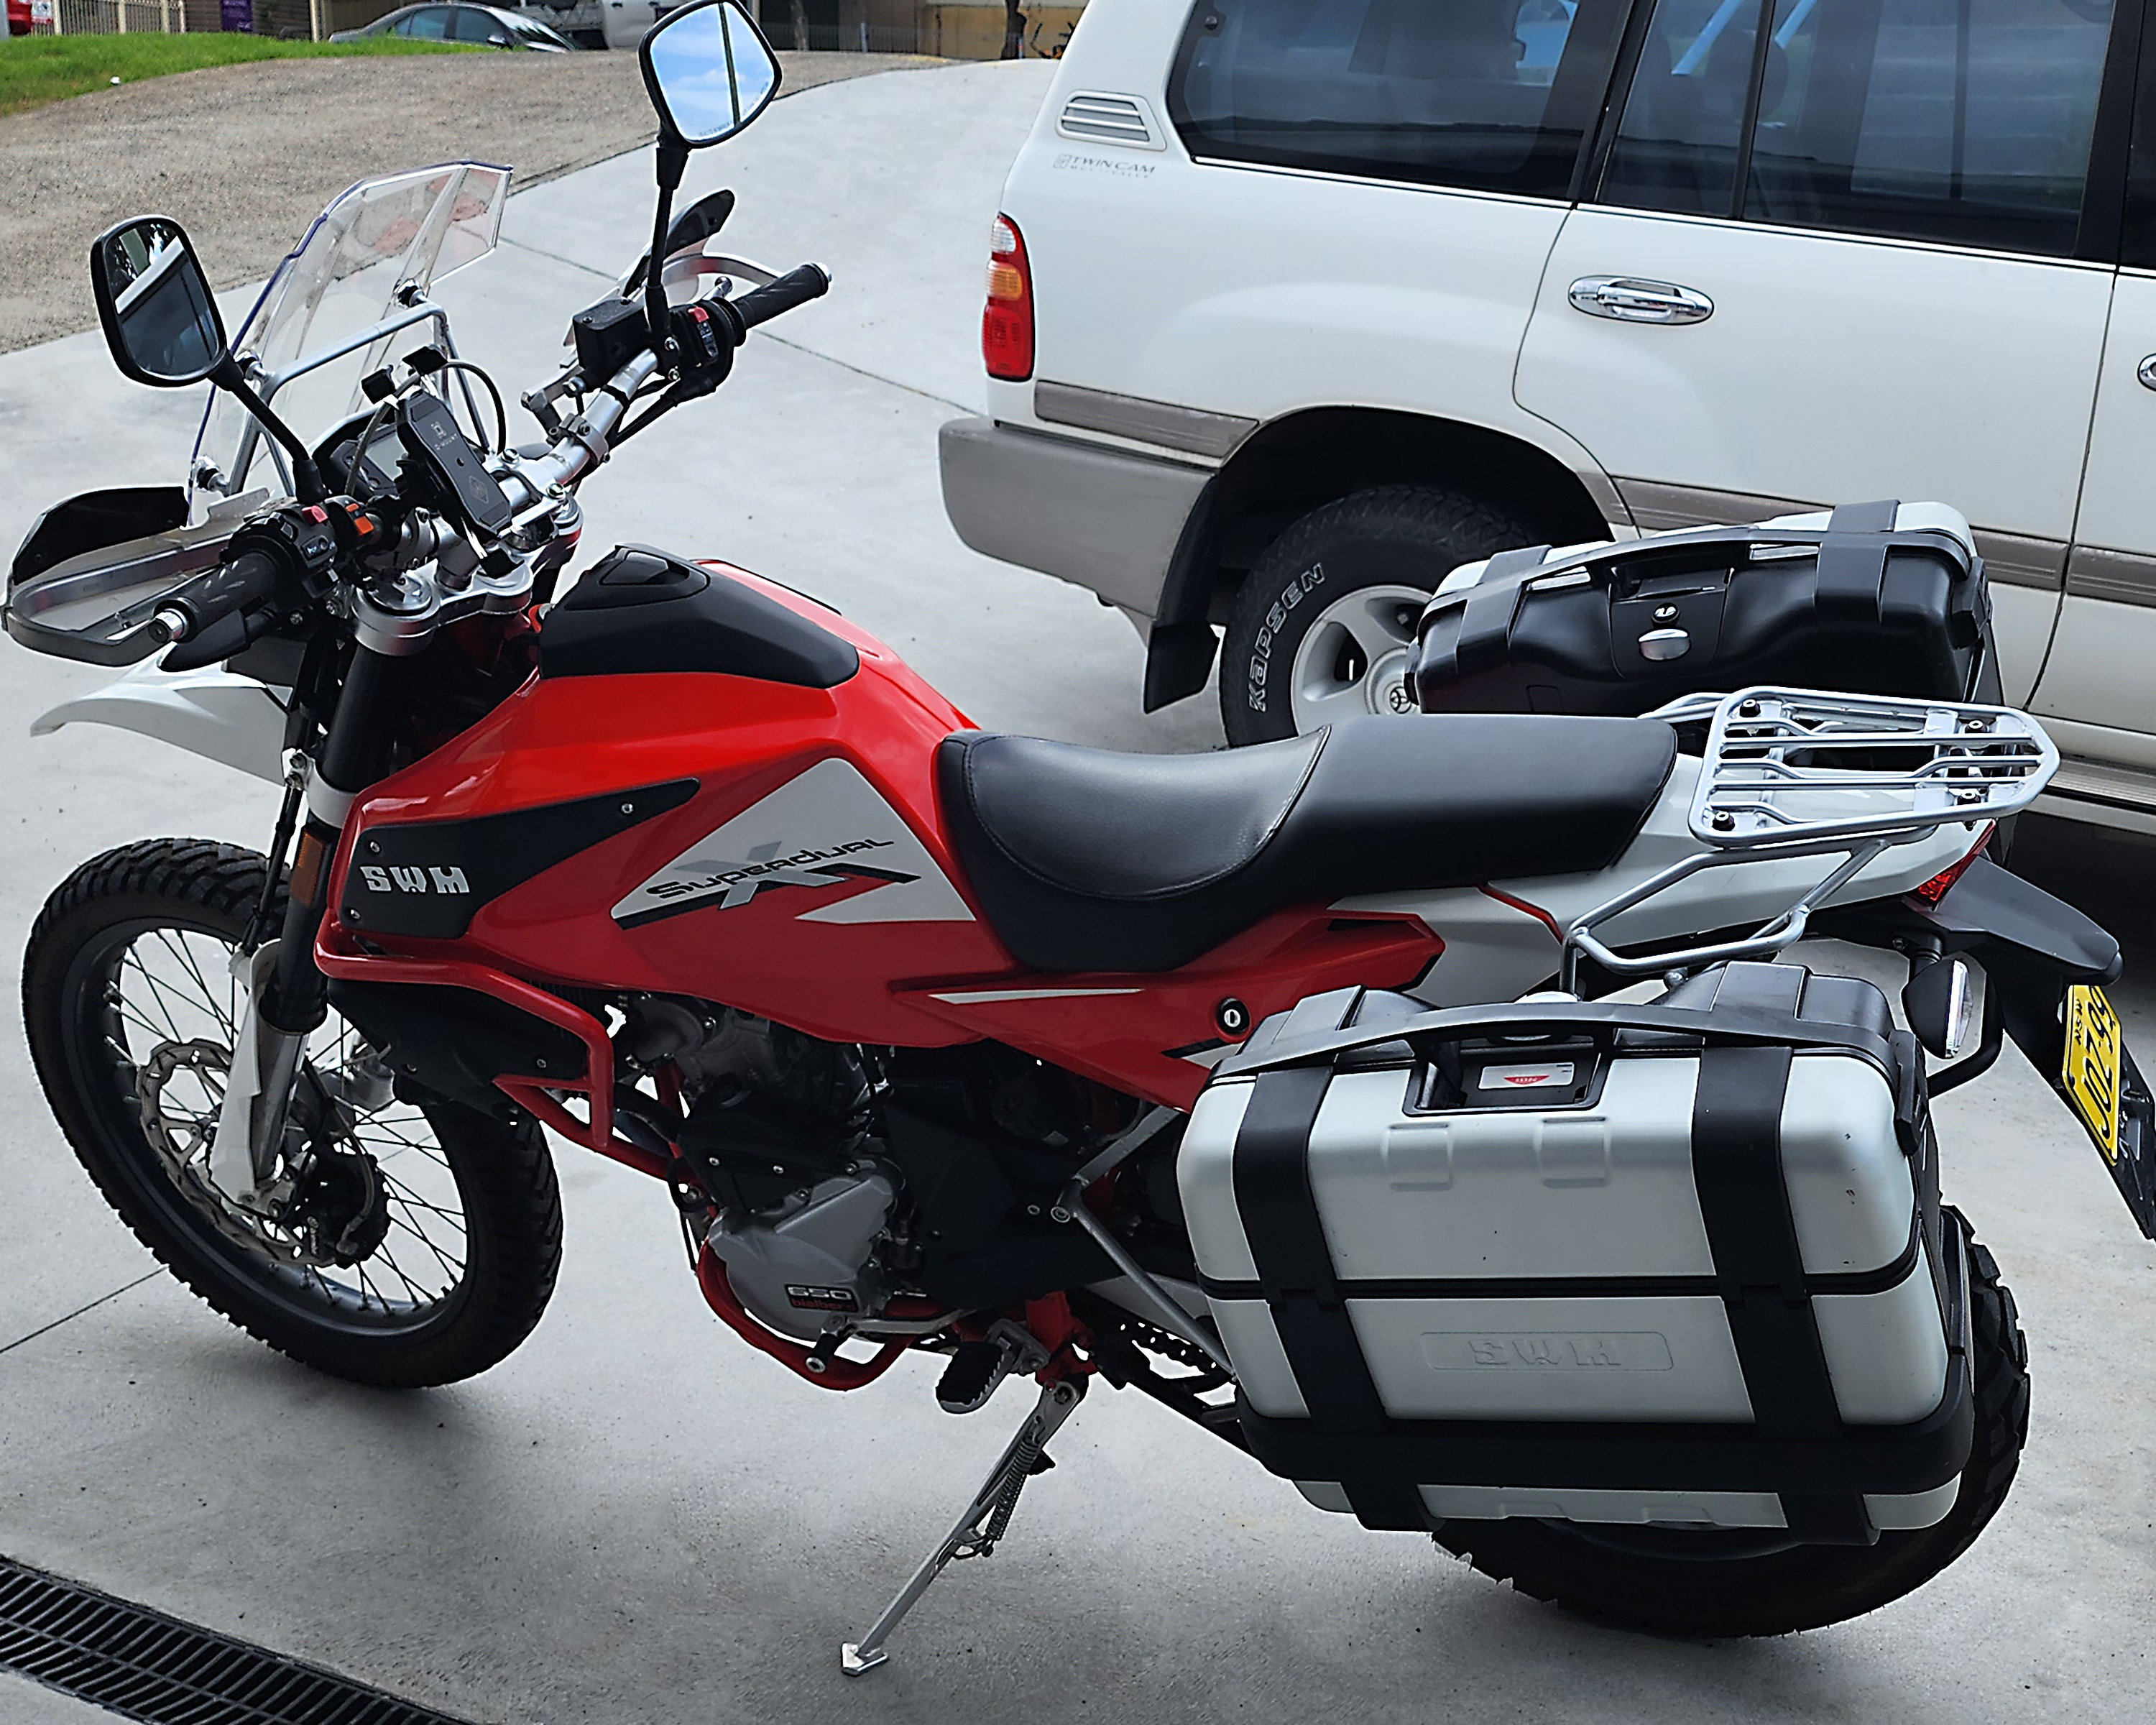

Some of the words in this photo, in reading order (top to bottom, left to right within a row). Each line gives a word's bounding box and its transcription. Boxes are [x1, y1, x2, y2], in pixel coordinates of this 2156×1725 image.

[1070, 155, 1111, 169] TWIN
[1115, 162, 1155, 173] CAM
[359, 865, 470, 893] SWM
[788, 1287, 852, 1300] 650
[1468, 1338, 1622, 1366] SWM
